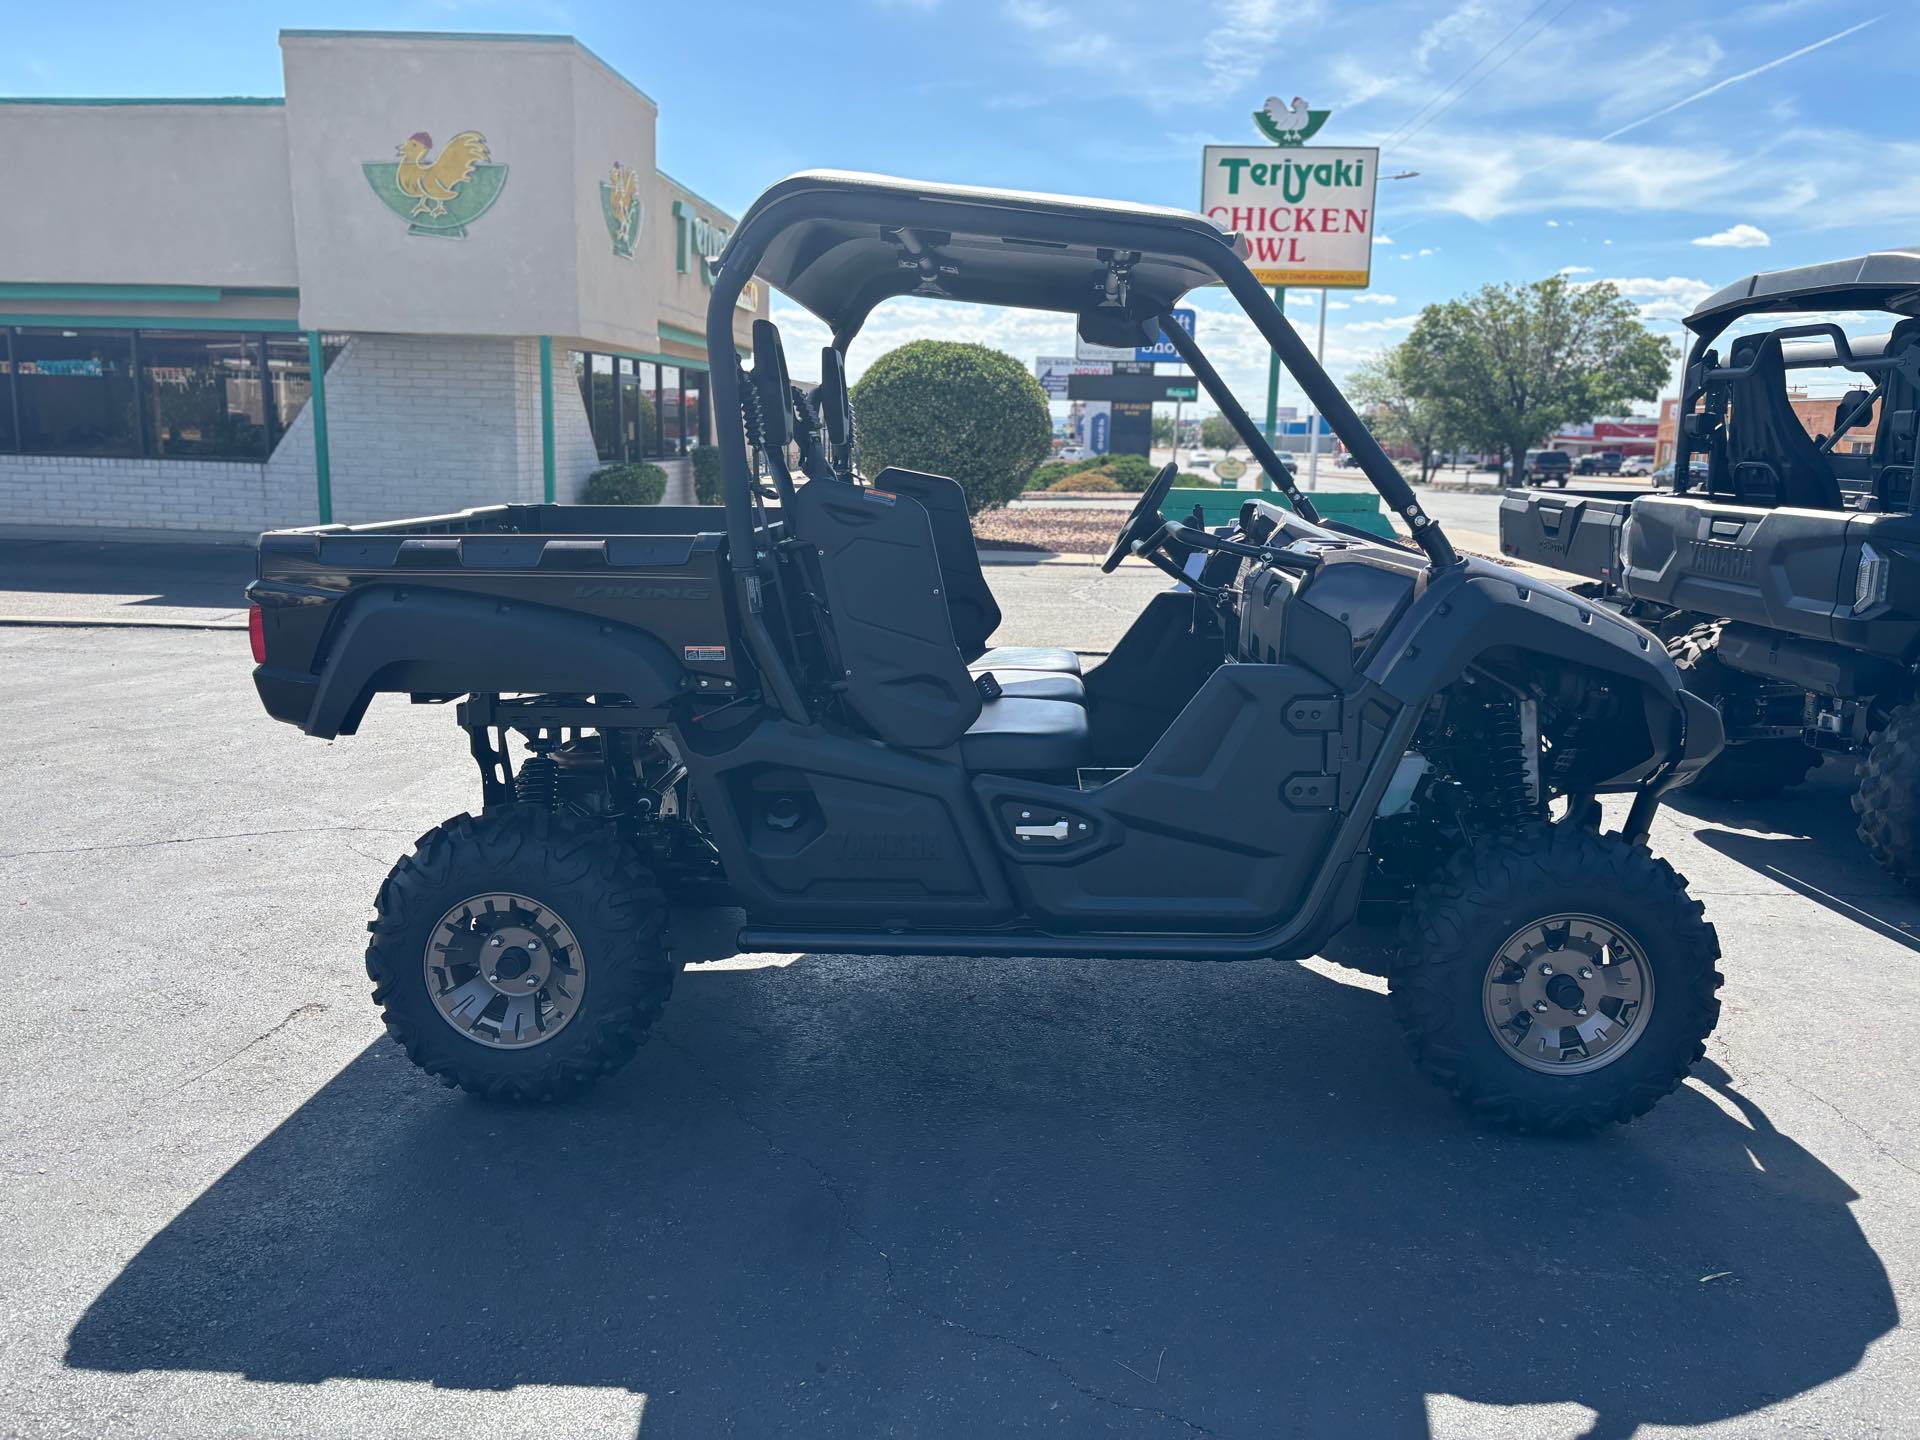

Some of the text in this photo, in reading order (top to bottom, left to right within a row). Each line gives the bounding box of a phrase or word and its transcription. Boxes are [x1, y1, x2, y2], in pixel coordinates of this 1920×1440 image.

[1218, 158, 1364, 204] Teriyaki
[1688, 541, 1753, 578] YAMAHA
[575, 586, 712, 600] VIKING
